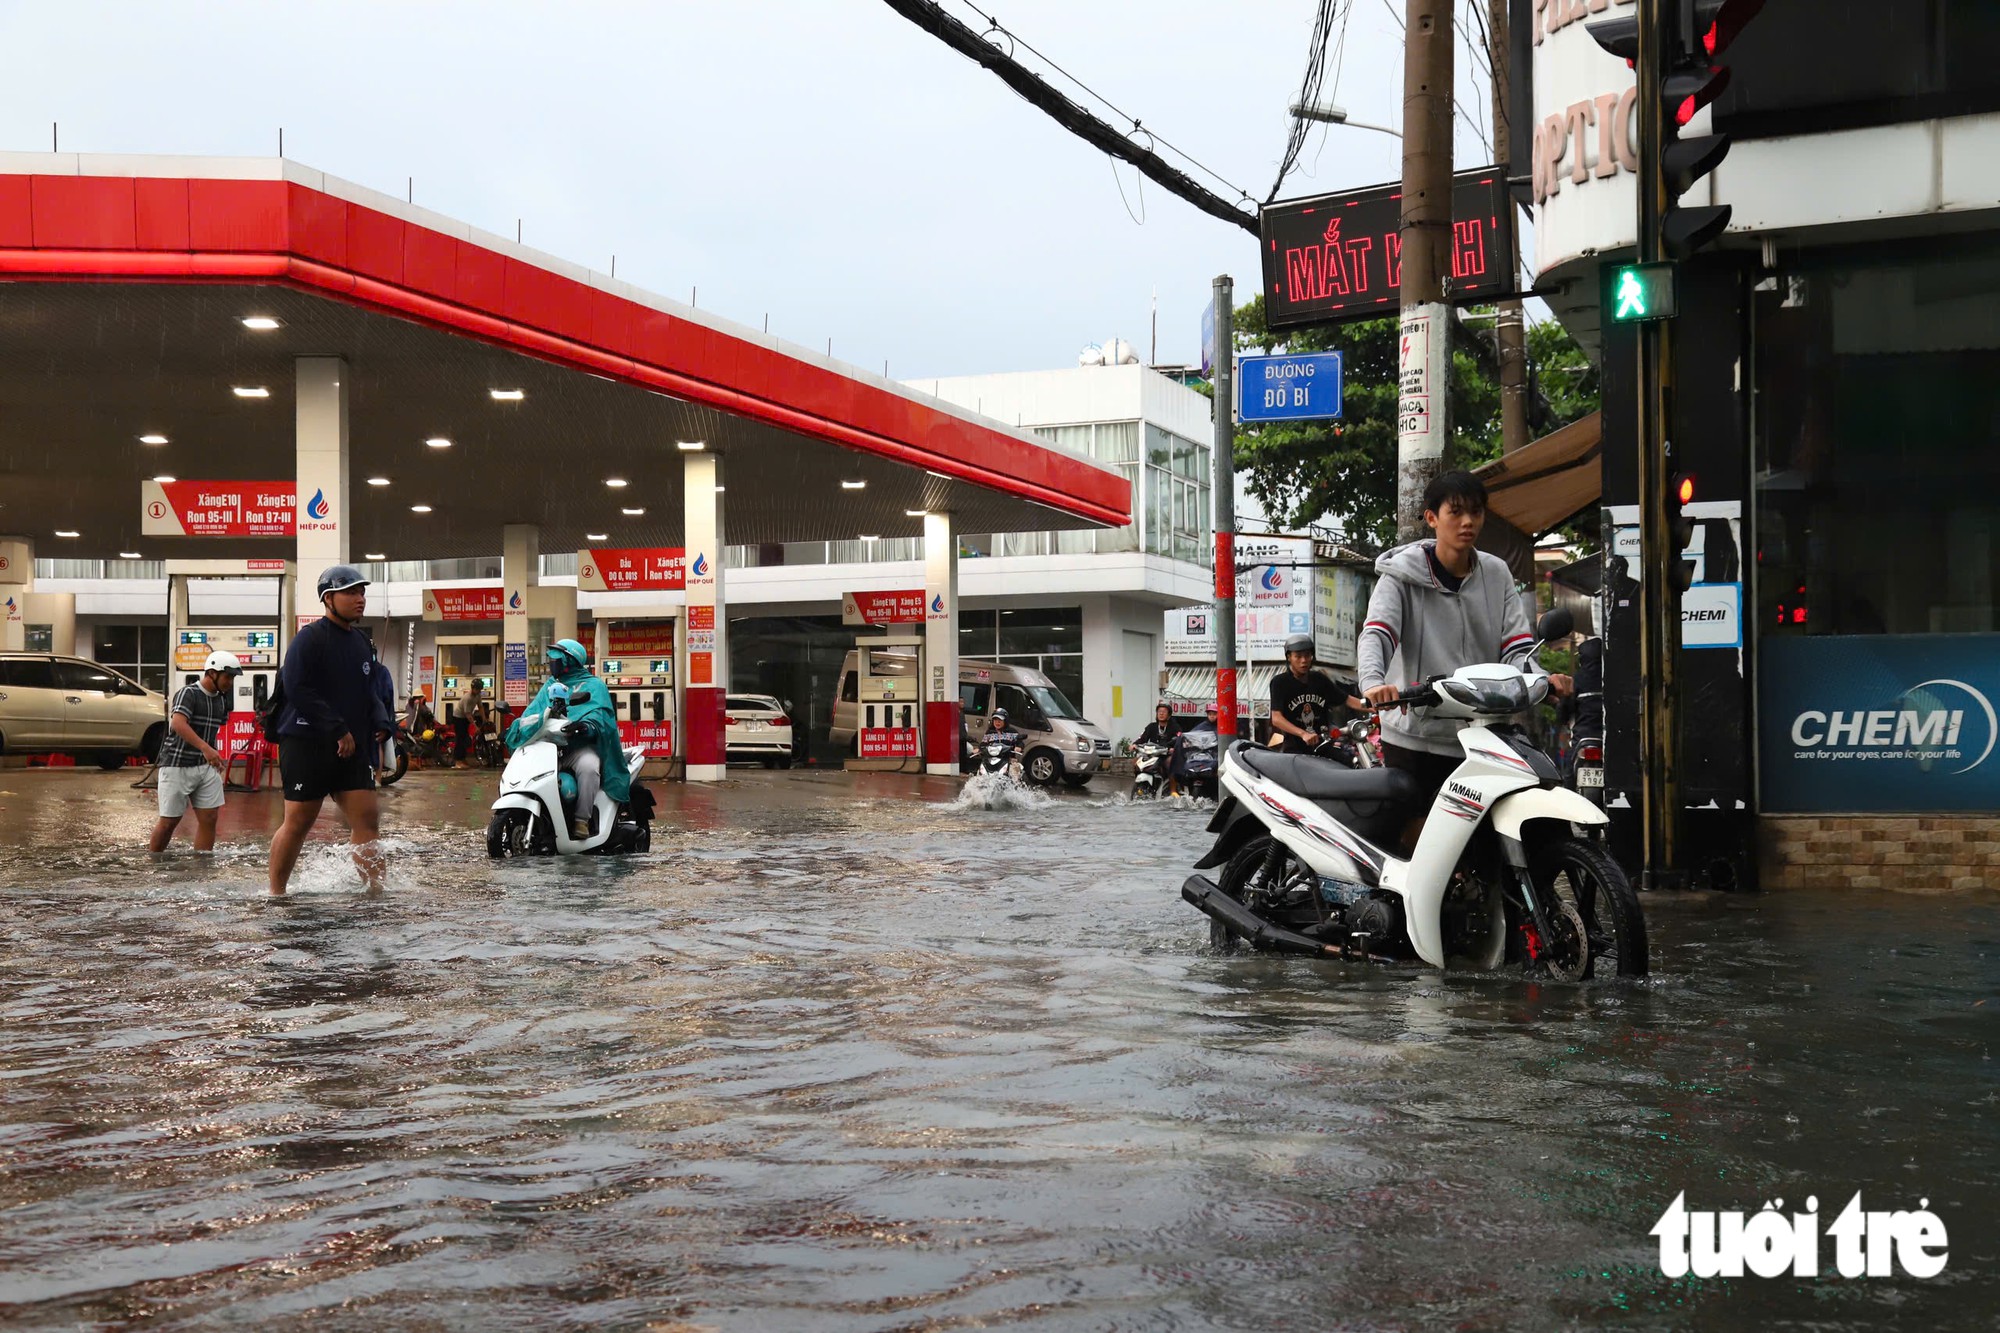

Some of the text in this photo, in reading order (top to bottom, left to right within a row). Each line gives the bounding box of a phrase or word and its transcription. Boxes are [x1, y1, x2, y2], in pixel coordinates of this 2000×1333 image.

[1286, 218, 1485, 302] MẮT KH
[1265, 361, 1314, 379] ĐƯỜNG
[1264, 382, 1311, 407] ĐỖ BÍ
[1664, 440, 1671, 457] 2
[153, 504, 161, 516] 1
[187, 511, 232, 523] Ron 95-III
[246, 511, 291, 523] Ron 97-III
[650, 571, 662, 580] Ron
[1681, 610, 1726, 622] CHEMI
[1791, 710, 1964, 746] CHEMI
[1794, 751, 1815, 759] care
[1817, 750, 1831, 759] for
[1832, 751, 1855, 761] your
[1882, 751, 1903, 759] care
[1920, 751, 1943, 760] your
[1946, 750, 1961, 758] life
[1448, 781, 1482, 802] YAMAHA
